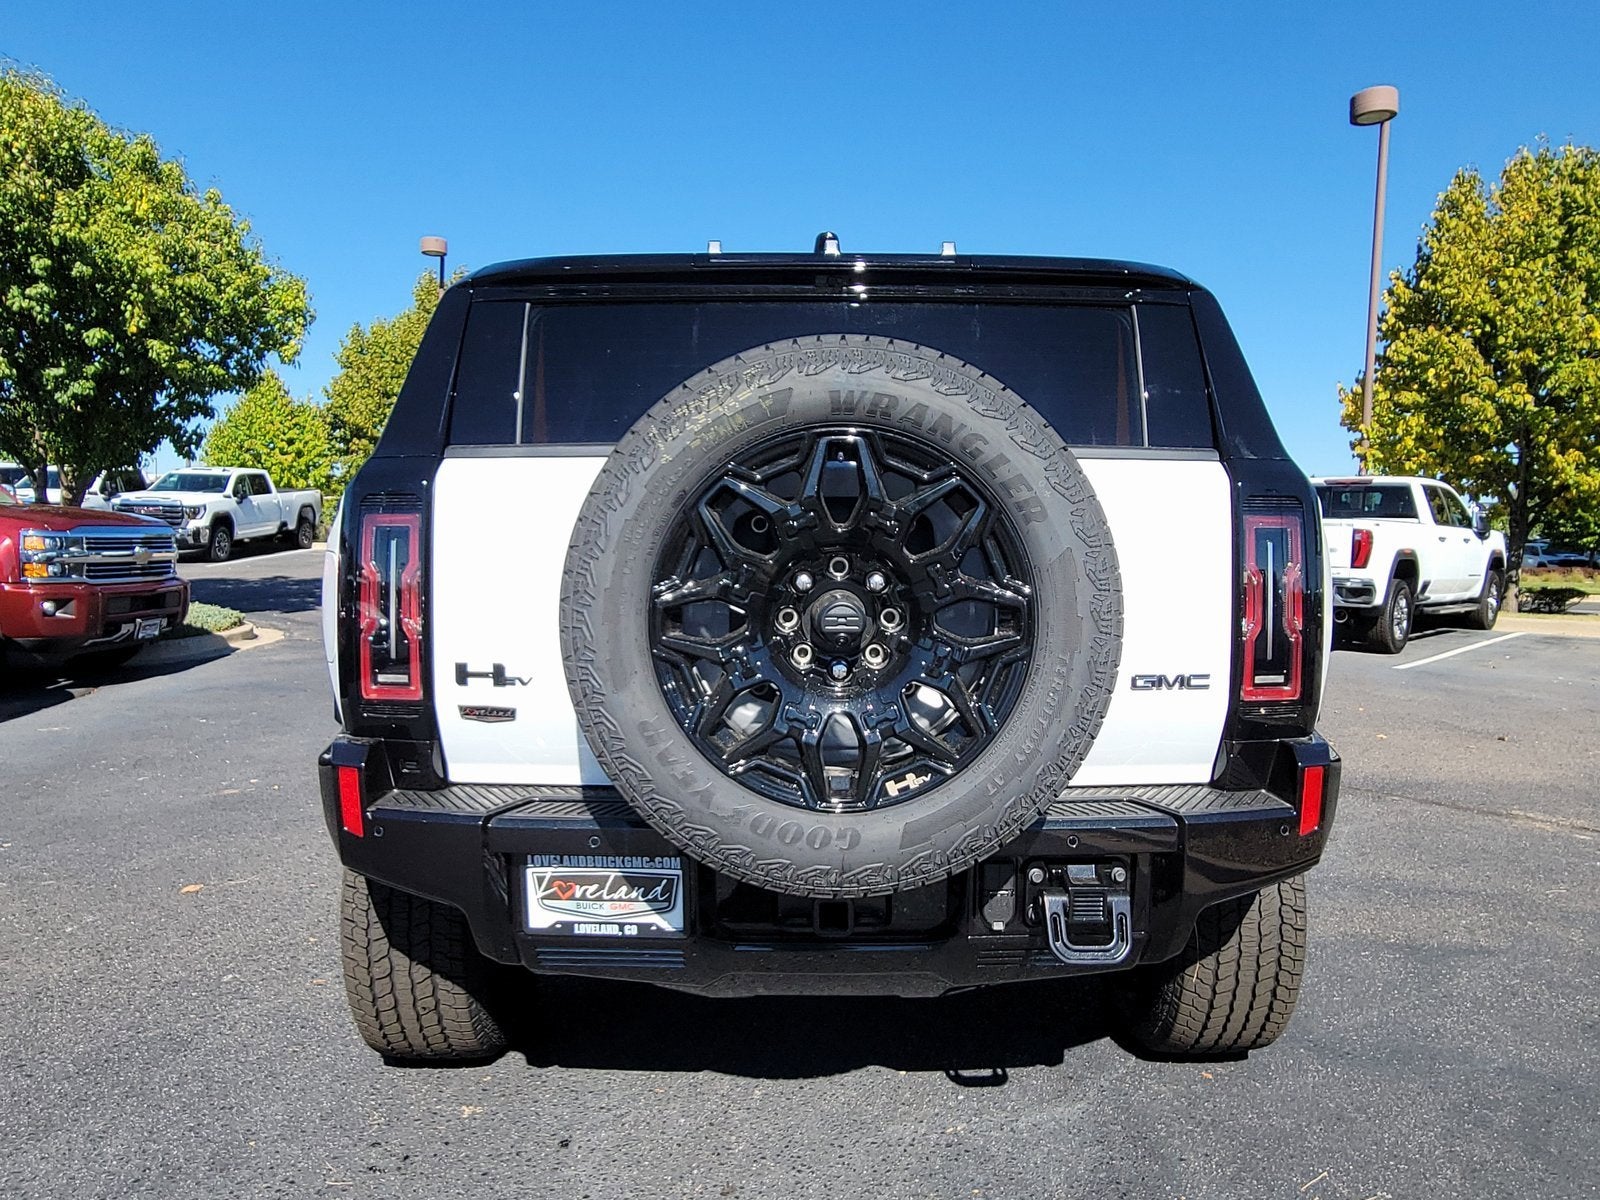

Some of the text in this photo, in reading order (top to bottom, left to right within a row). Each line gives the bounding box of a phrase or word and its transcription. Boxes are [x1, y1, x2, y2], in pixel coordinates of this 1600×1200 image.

[828, 389, 1048, 526] WRANGLER
[1130, 673, 1211, 691] GMC
[527, 854, 681, 869] LOVELANDBUICKGMC.COM
[576, 902, 635, 911] BUICK GMC
[623, 924, 638, 936] CO
